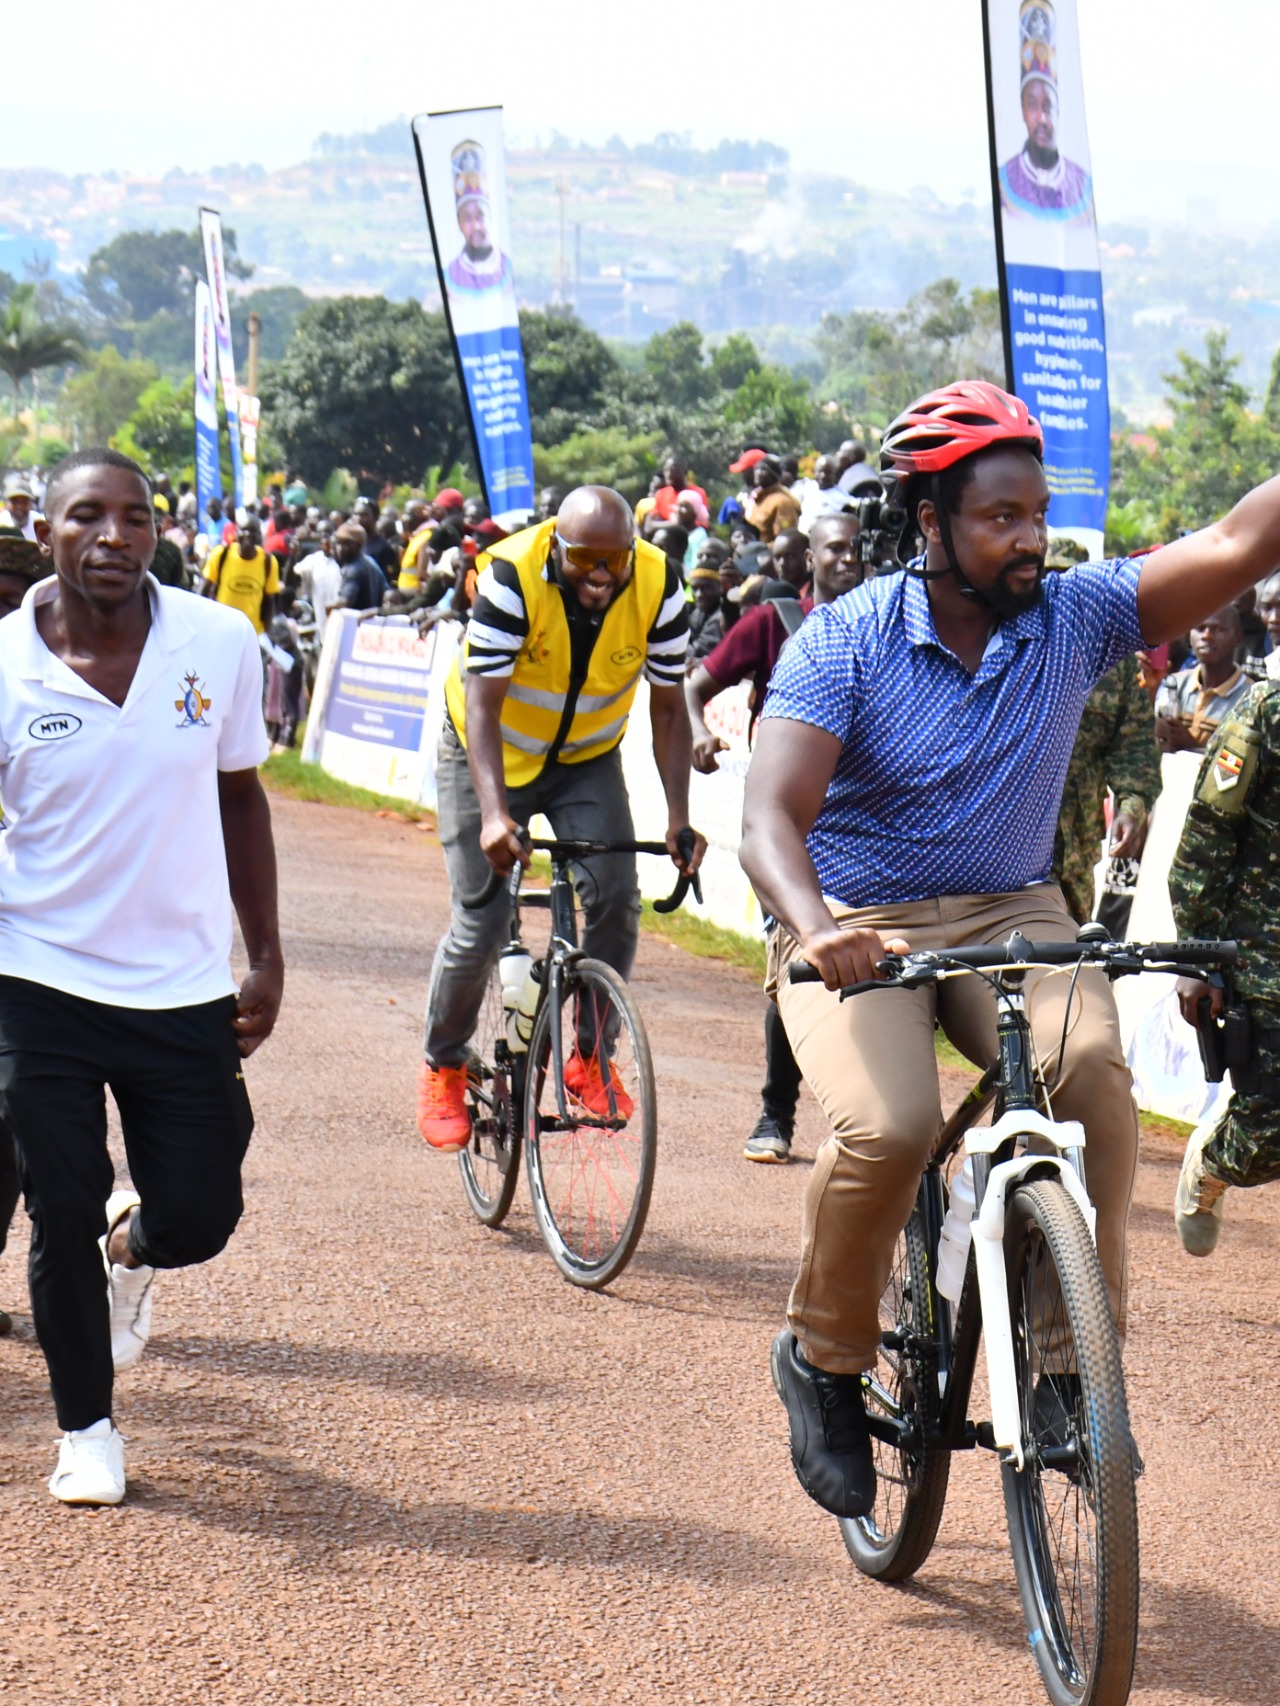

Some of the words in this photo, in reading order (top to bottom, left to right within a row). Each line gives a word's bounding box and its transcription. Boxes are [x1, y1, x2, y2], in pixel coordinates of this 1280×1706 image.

[1012, 288, 1037, 305] Men
[1039, 293, 1057, 308] are
[1058, 295, 1098, 311] pillars
[1023, 309, 1036, 325] in
[1015, 331, 1046, 347] good
[1080, 374, 1102, 390] for
[41, 719, 69, 735] MTN
